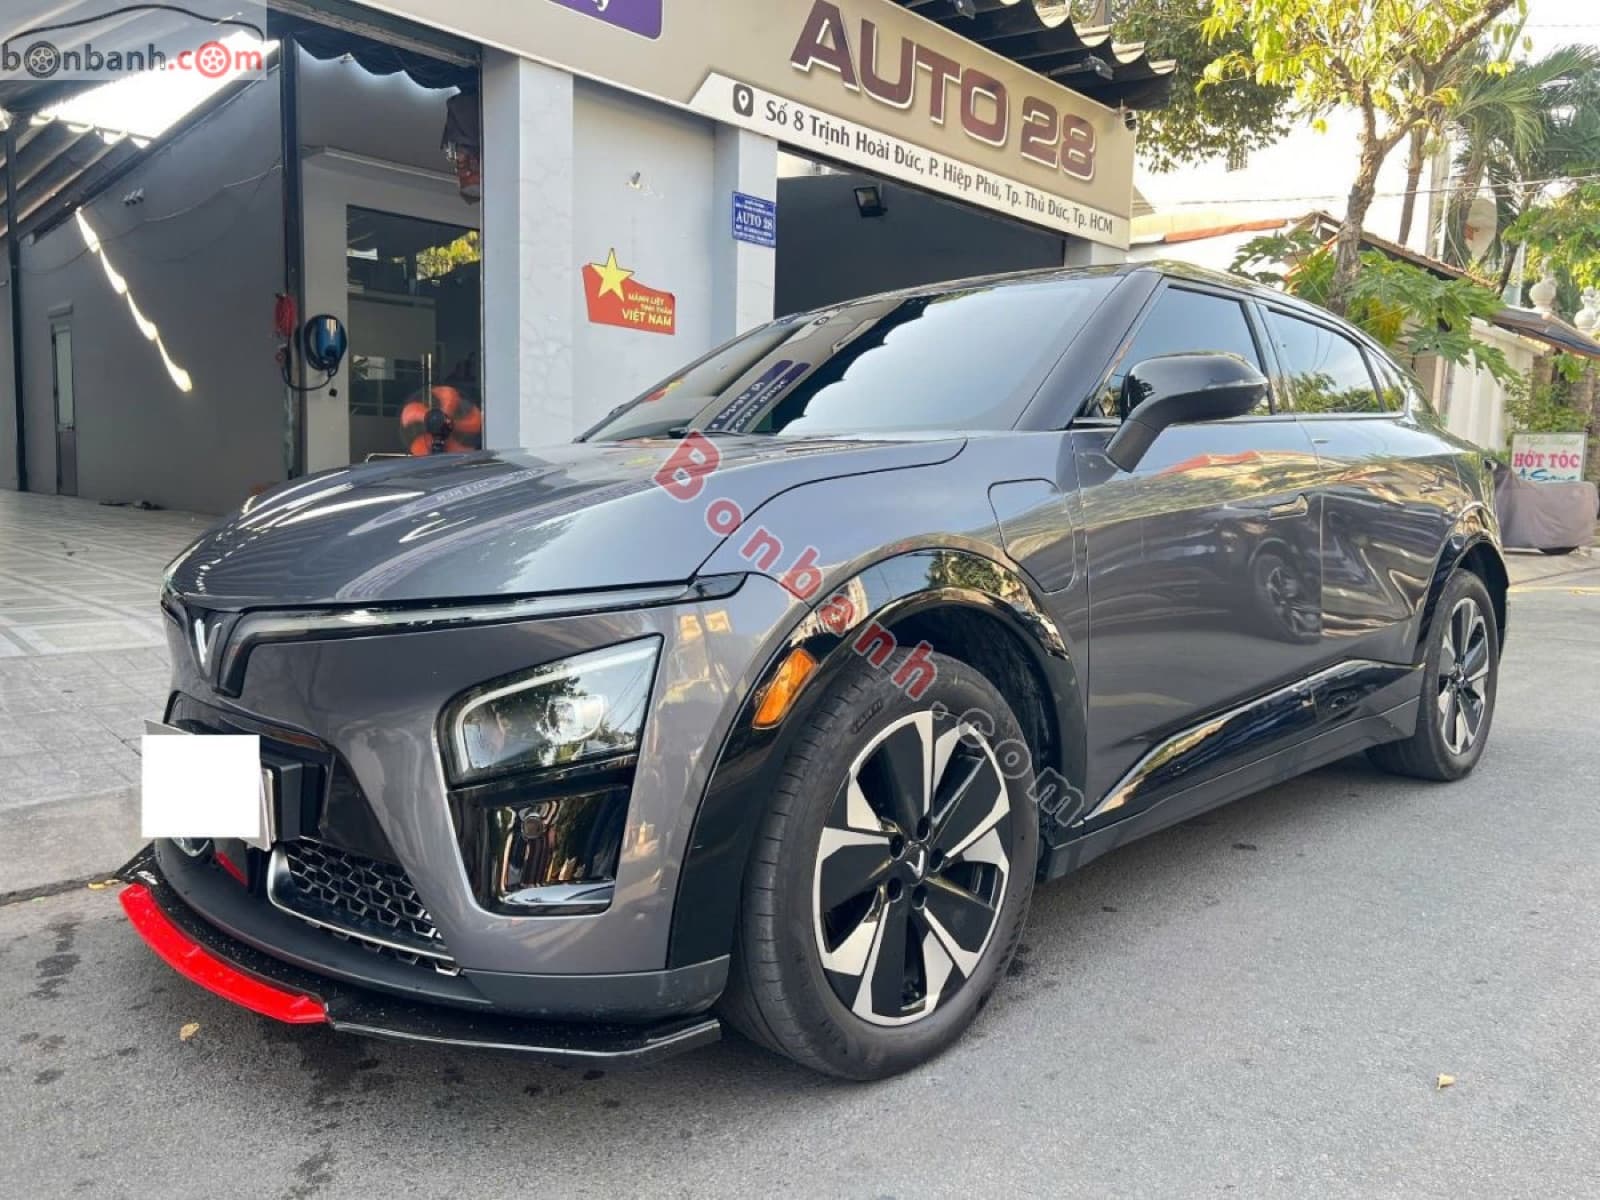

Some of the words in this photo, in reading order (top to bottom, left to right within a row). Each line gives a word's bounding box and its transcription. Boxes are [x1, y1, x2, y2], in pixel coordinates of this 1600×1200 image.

[790, 0, 1009, 147] AUTO
[1020, 96, 1097, 181] 28
[765, 100, 788, 126] Số
[792, 110, 804, 131] 8
[809, 114, 850, 146] Trịnh
[855, 131, 890, 160] Hoài
[894, 145, 924, 175] Đức,
[928, 157, 939, 177] P.
[943, 164, 972, 192] Hiệp
[975, 174, 1002, 200] Phú,
[1004, 183, 1021, 207] Tp.
[1024, 190, 1045, 213] Thủ
[1073, 207, 1087, 229] Tp.
[1089, 212, 1113, 235] HCM
[735, 209, 761, 227] AUTO
[621, 307, 645, 323] VIỆT
[647, 313, 672, 327] NAM
